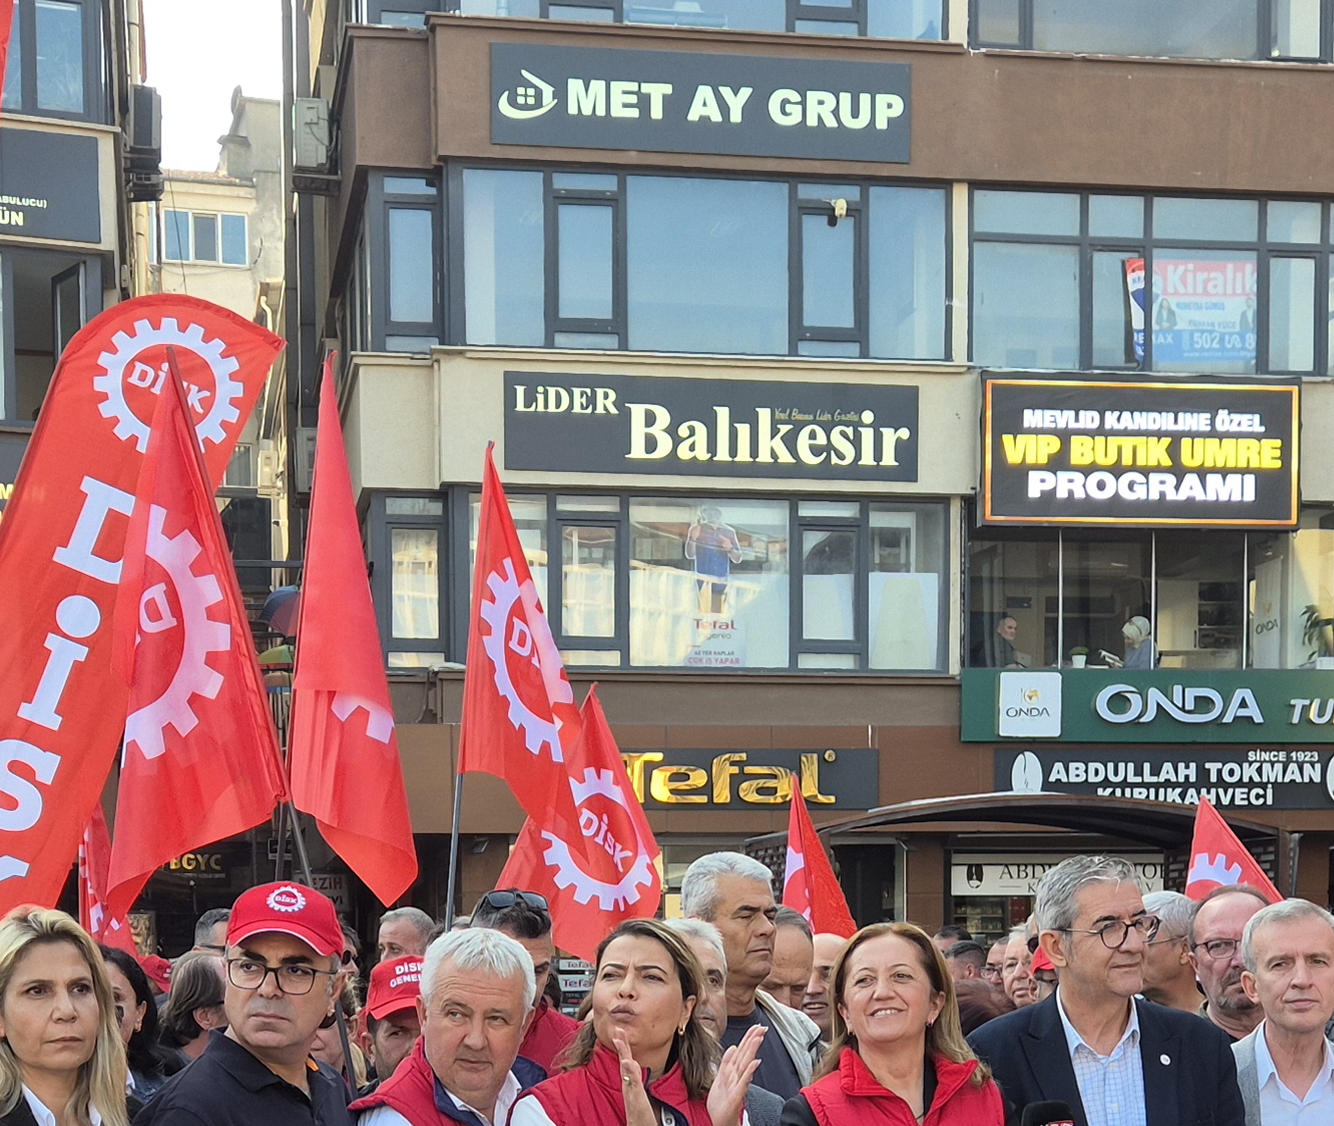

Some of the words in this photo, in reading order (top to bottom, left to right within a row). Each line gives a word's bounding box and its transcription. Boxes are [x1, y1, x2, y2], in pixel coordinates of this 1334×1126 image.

[567, 77, 673, 120] MET
[686, 85, 754, 123] AY
[767, 88, 905, 130] GRUP
[1167, 263, 1257, 295] Kiralık
[127, 361, 211, 414] DİK
[624, 402, 910, 467] Balıkesir
[1023, 408, 1100, 429] MEVLID
[1215, 409, 1266, 433] ÖZEL
[1001, 433, 1062, 465] VIP
[1180, 437, 1283, 469] UMRE
[1027, 470, 1256, 502] PROGRAMI
[1005, 706, 1051, 718] ONDA
[1095, 683, 1265, 725] ONDA
[1048, 762, 1197, 784] ABDULLAH
[1204, 761, 1322, 784] TOKMAN
[1289, 750, 1319, 762] 1923
[622, 752, 836, 804] Tefal
[579, 806, 634, 875] DİSK
[562, 978, 592, 988] Tefa
